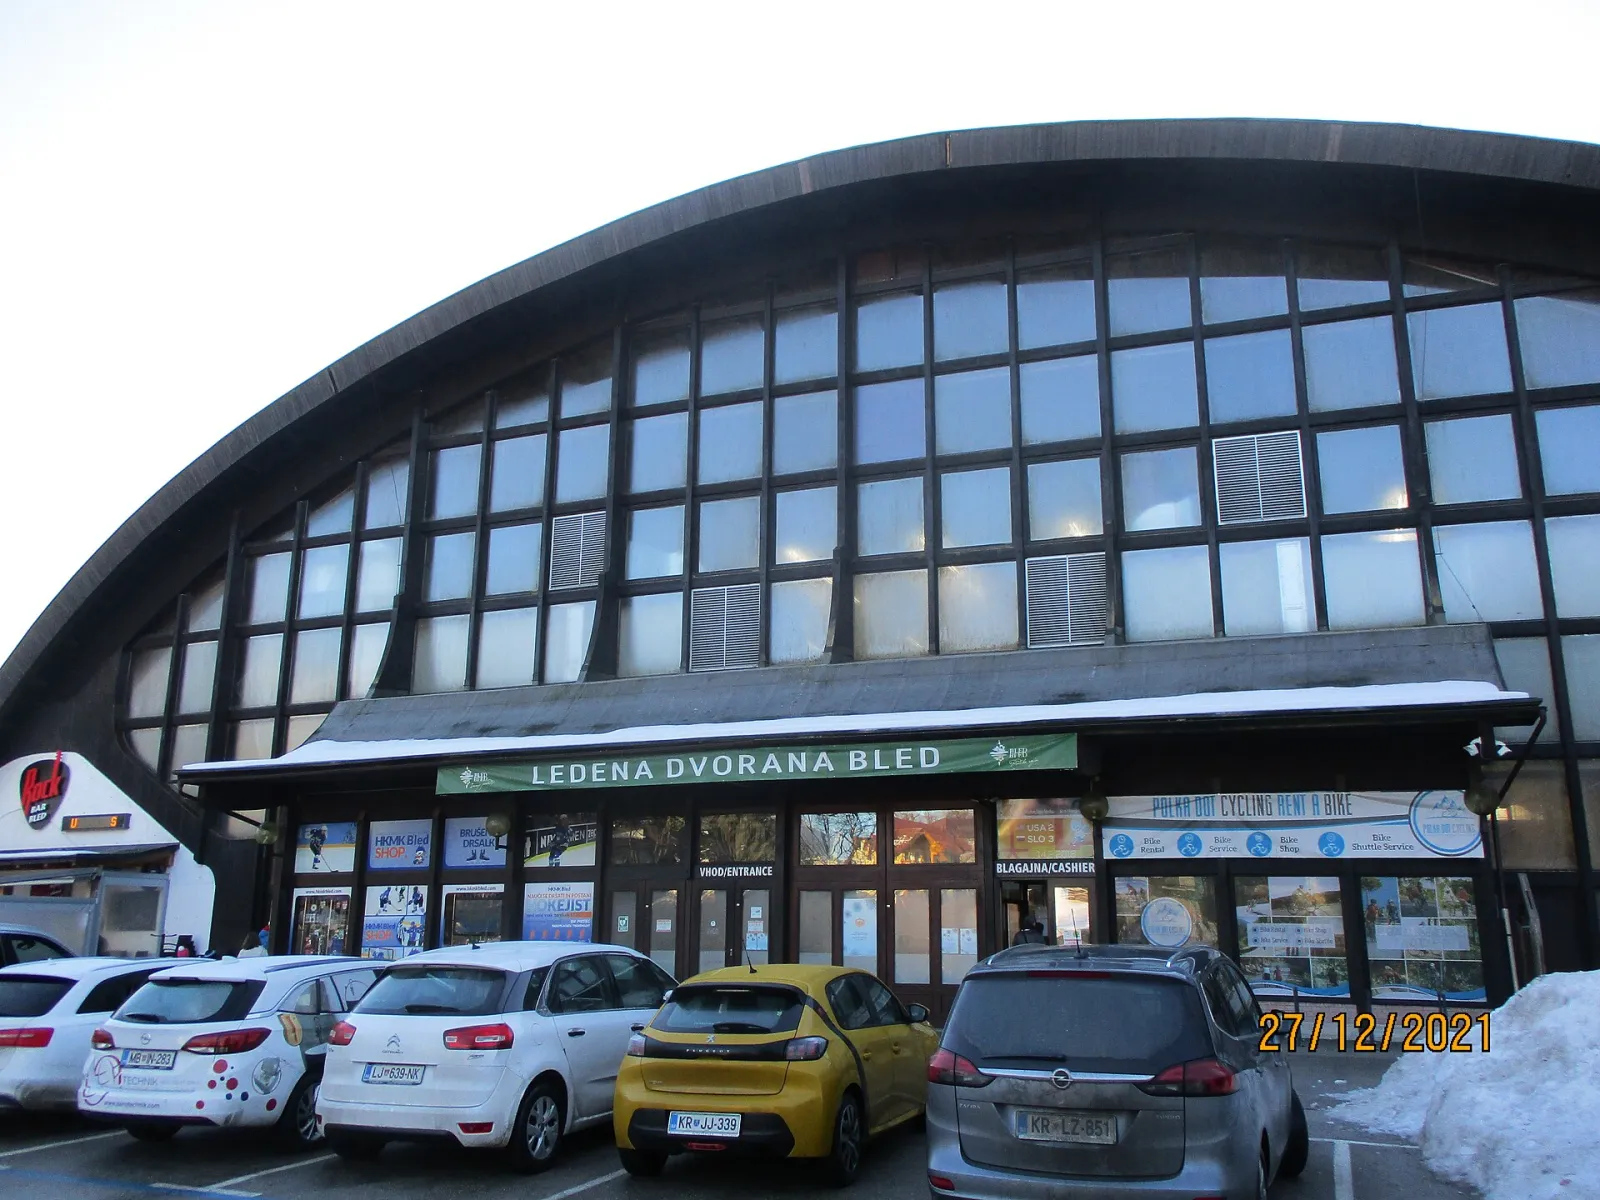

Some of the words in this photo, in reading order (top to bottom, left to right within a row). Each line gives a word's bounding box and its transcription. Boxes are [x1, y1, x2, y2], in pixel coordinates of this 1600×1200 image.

[532, 760, 654, 785] LEDENA
[666, 752, 835, 779] DVORANA
[849, 747, 940, 771] BLED
[30, 803, 47, 814] BAR
[1152, 796, 1191, 818] POLKA
[1195, 795, 1216, 817] DOT
[1220, 794, 1273, 817] CYCLING
[1277, 794, 1306, 817] RENT
[1312, 794, 1320, 816] A
[1324, 793, 1353, 816] BIKE
[28, 812, 47, 824] BLED
[460, 827, 488, 838] BRUŠE
[1027, 823, 1047, 832] USA
[1048, 823, 1055, 832] 2
[375, 835, 405, 846] HKMK
[407, 834, 429, 846] Bled
[1027, 835, 1046, 843] SLO
[1049, 835, 1055, 843] 3
[1372, 834, 1391, 842] Bike
[1140, 846, 1165, 854] Rental
[1209, 845, 1238, 853] Service
[1279, 845, 1300, 854] Shop
[1352, 843, 1382, 851] Shuttle
[700, 866, 773, 878] VHOD/ENTRANCE
[996, 862, 1095, 874] BLAGAJNA/CASHIER
[128, 1053, 141, 1065] MB
[372, 1066, 383, 1079] LJ
[389, 1067, 421, 1080] 639-NK
[678, 1116, 693, 1129] KR
[700, 1117, 737, 1131] JJ-339
[1031, 1115, 1051, 1134] KR
